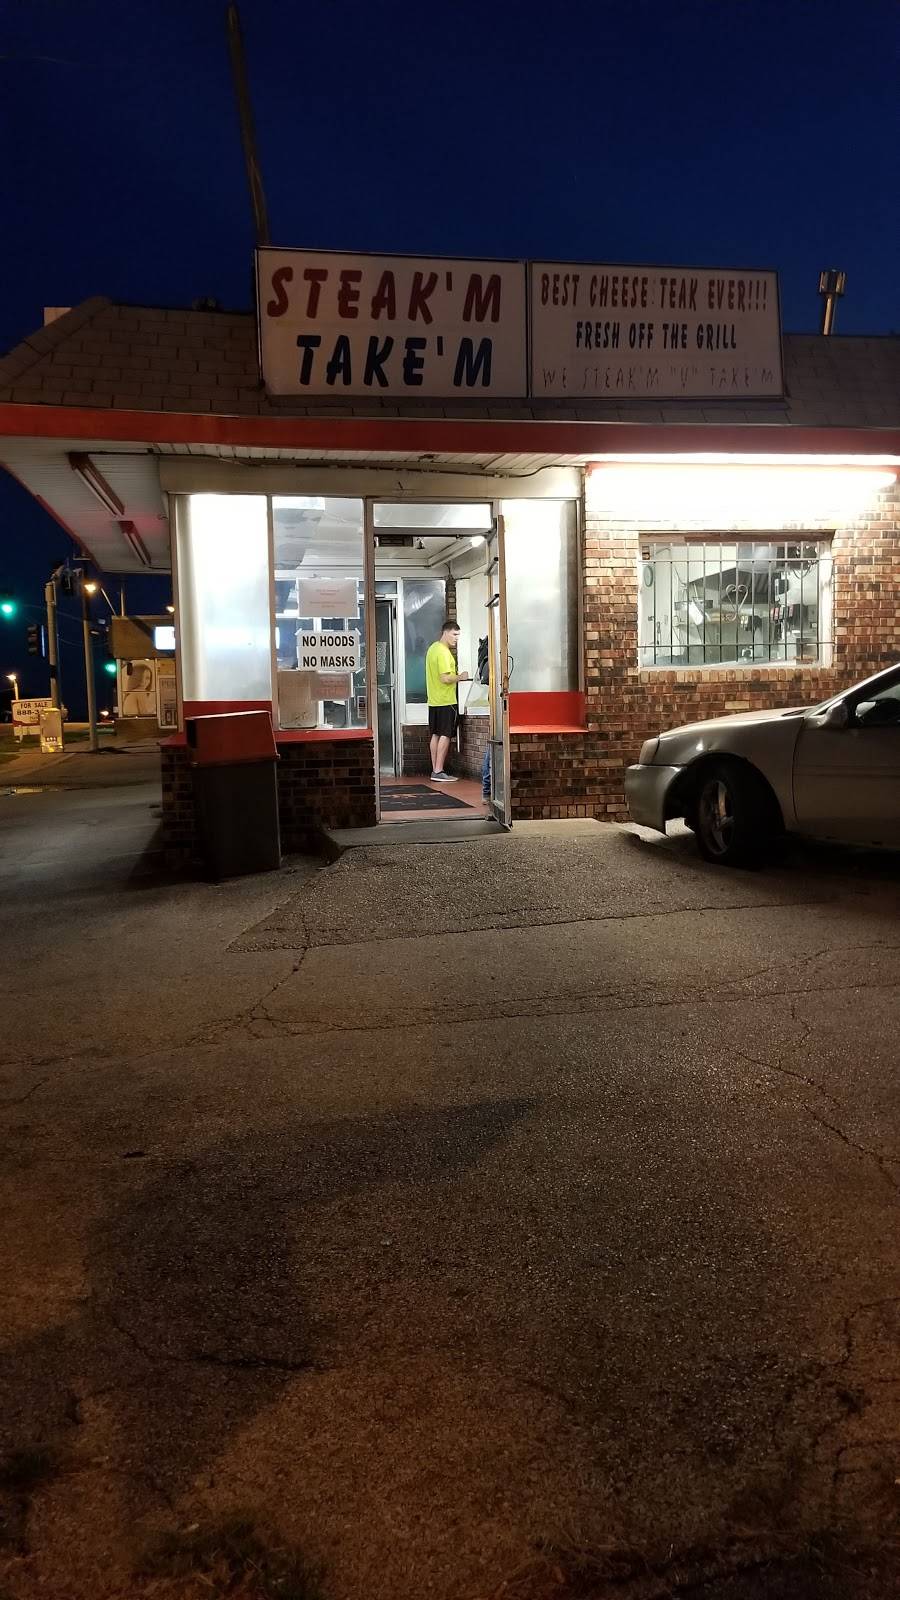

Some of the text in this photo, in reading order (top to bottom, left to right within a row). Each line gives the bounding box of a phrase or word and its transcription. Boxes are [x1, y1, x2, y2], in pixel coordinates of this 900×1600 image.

[266, 266, 502, 325] STEAK'M
[541, 273, 580, 306] BEST
[707, 279, 767, 313] EVER!!!
[576, 321, 737, 351] FRESH OFF THE GRILL
[296, 334, 493, 387] TAKE'M
[302, 636, 355, 647] NO HOODS
[303, 656, 355, 667] NO MASKS
